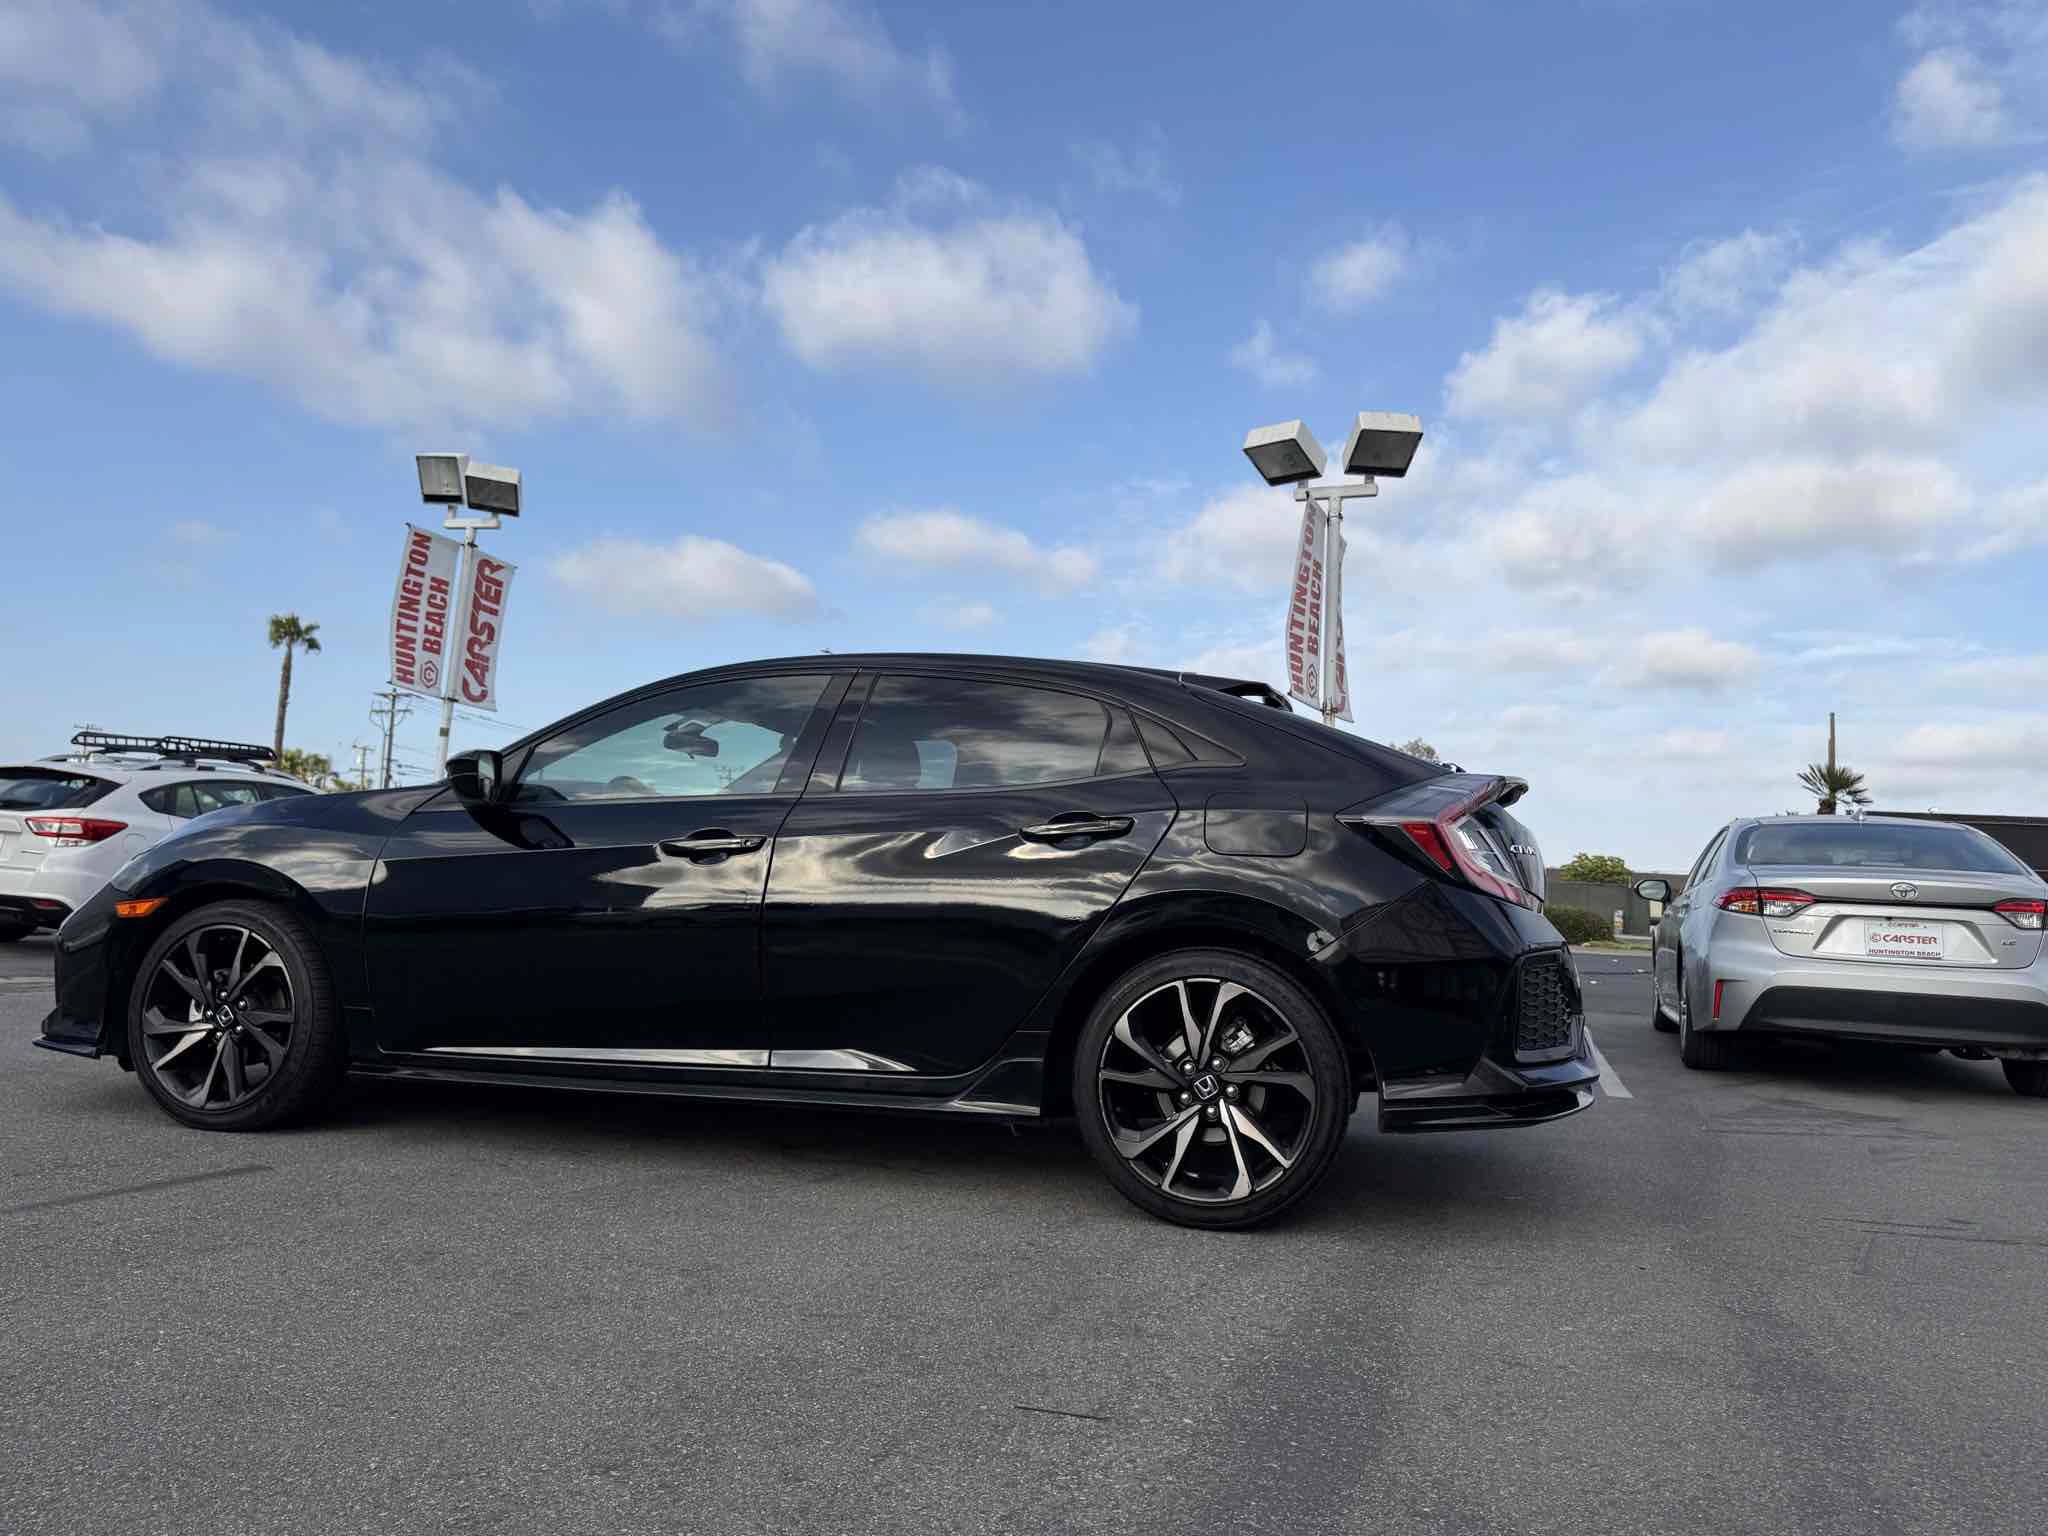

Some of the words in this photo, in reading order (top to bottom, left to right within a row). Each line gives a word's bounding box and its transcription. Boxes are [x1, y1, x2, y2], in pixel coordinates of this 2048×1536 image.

[395, 532, 432, 685] HUNTINGTON
[422, 575, 450, 656] BEACH
[463, 558, 505, 703] CARSTER
[1308, 559, 1323, 657] BEACH
[1869, 948, 1915, 957] HUNTINGTON
[1883, 934, 1937, 945] CARSTER
